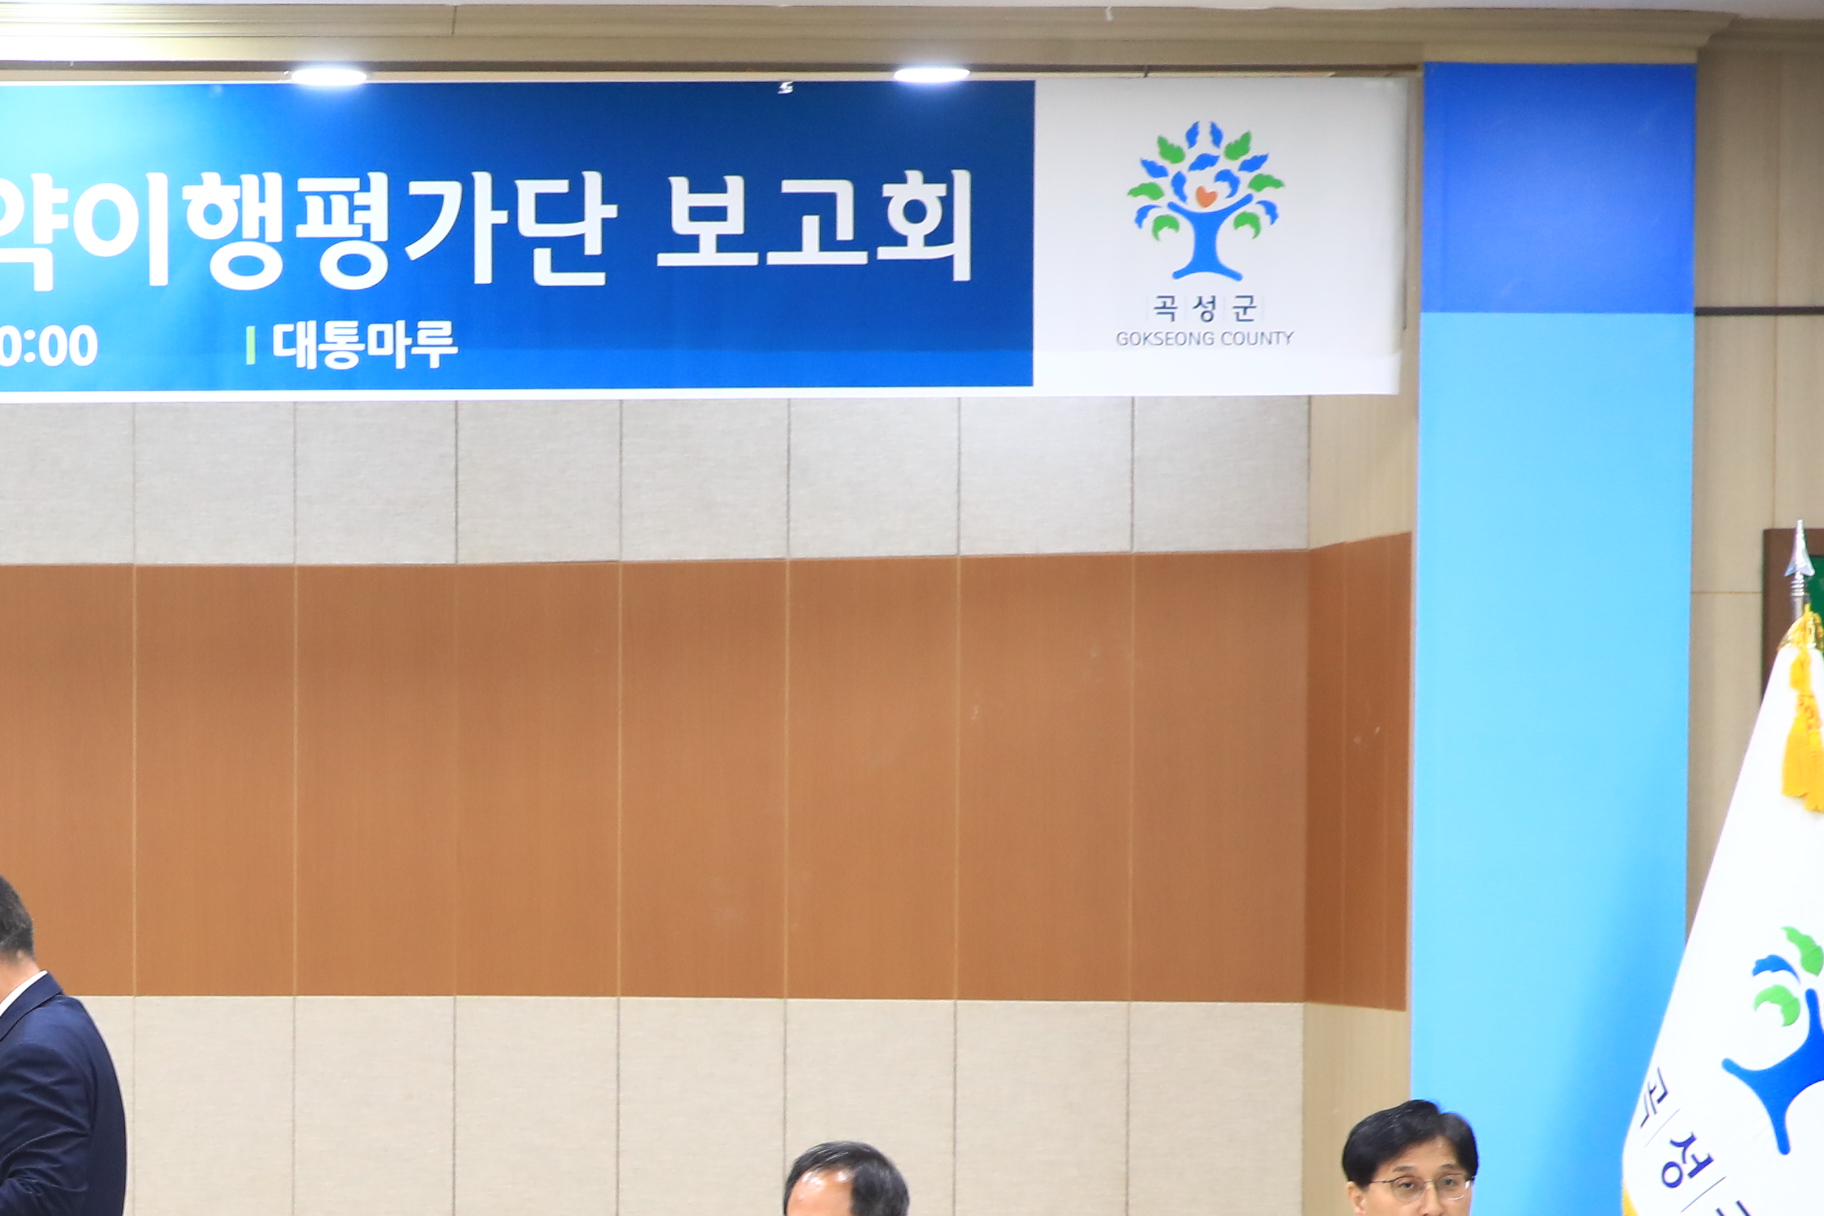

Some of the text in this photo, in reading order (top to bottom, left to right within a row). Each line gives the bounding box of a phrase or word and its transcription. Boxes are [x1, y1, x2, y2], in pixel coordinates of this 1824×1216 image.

[656, 168, 973, 283] 보고회
[272, 320, 459, 370] 대통마루
[1116, 330, 1295, 346] GOKSEONG COUNTY
